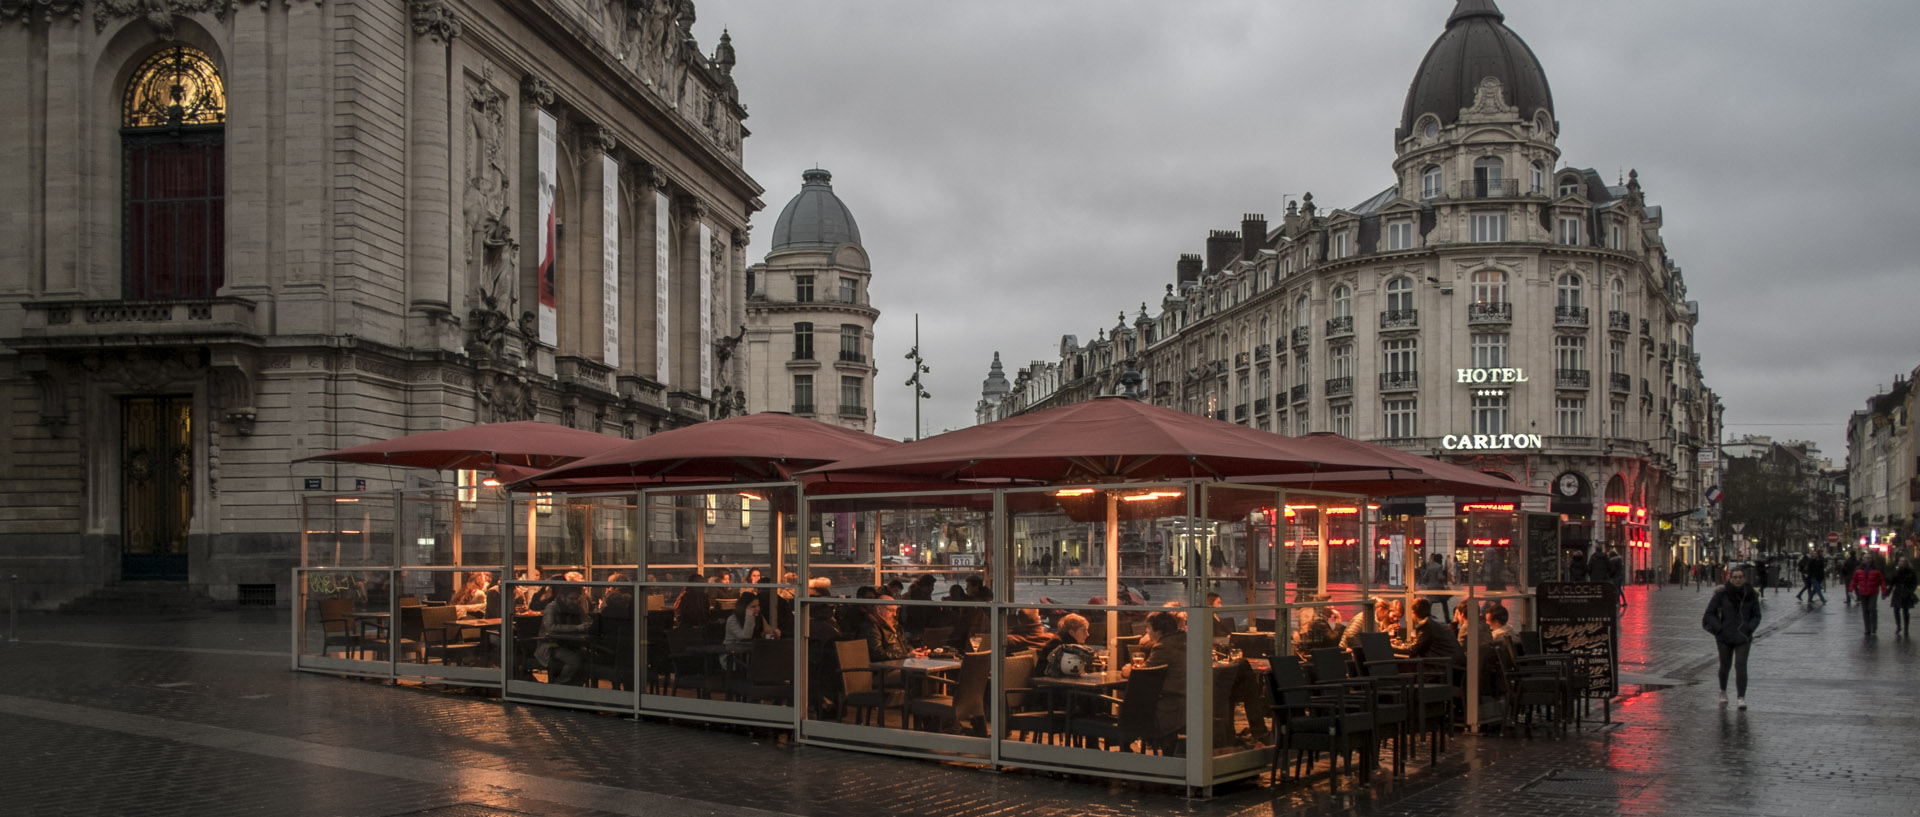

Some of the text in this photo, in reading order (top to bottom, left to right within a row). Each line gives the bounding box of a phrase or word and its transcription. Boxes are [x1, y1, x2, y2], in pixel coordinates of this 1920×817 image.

[1456, 368, 1529, 383] HOTEL
[1442, 433, 1542, 450] CARLTON
[1547, 584, 1603, 594] LA CLOCHE
